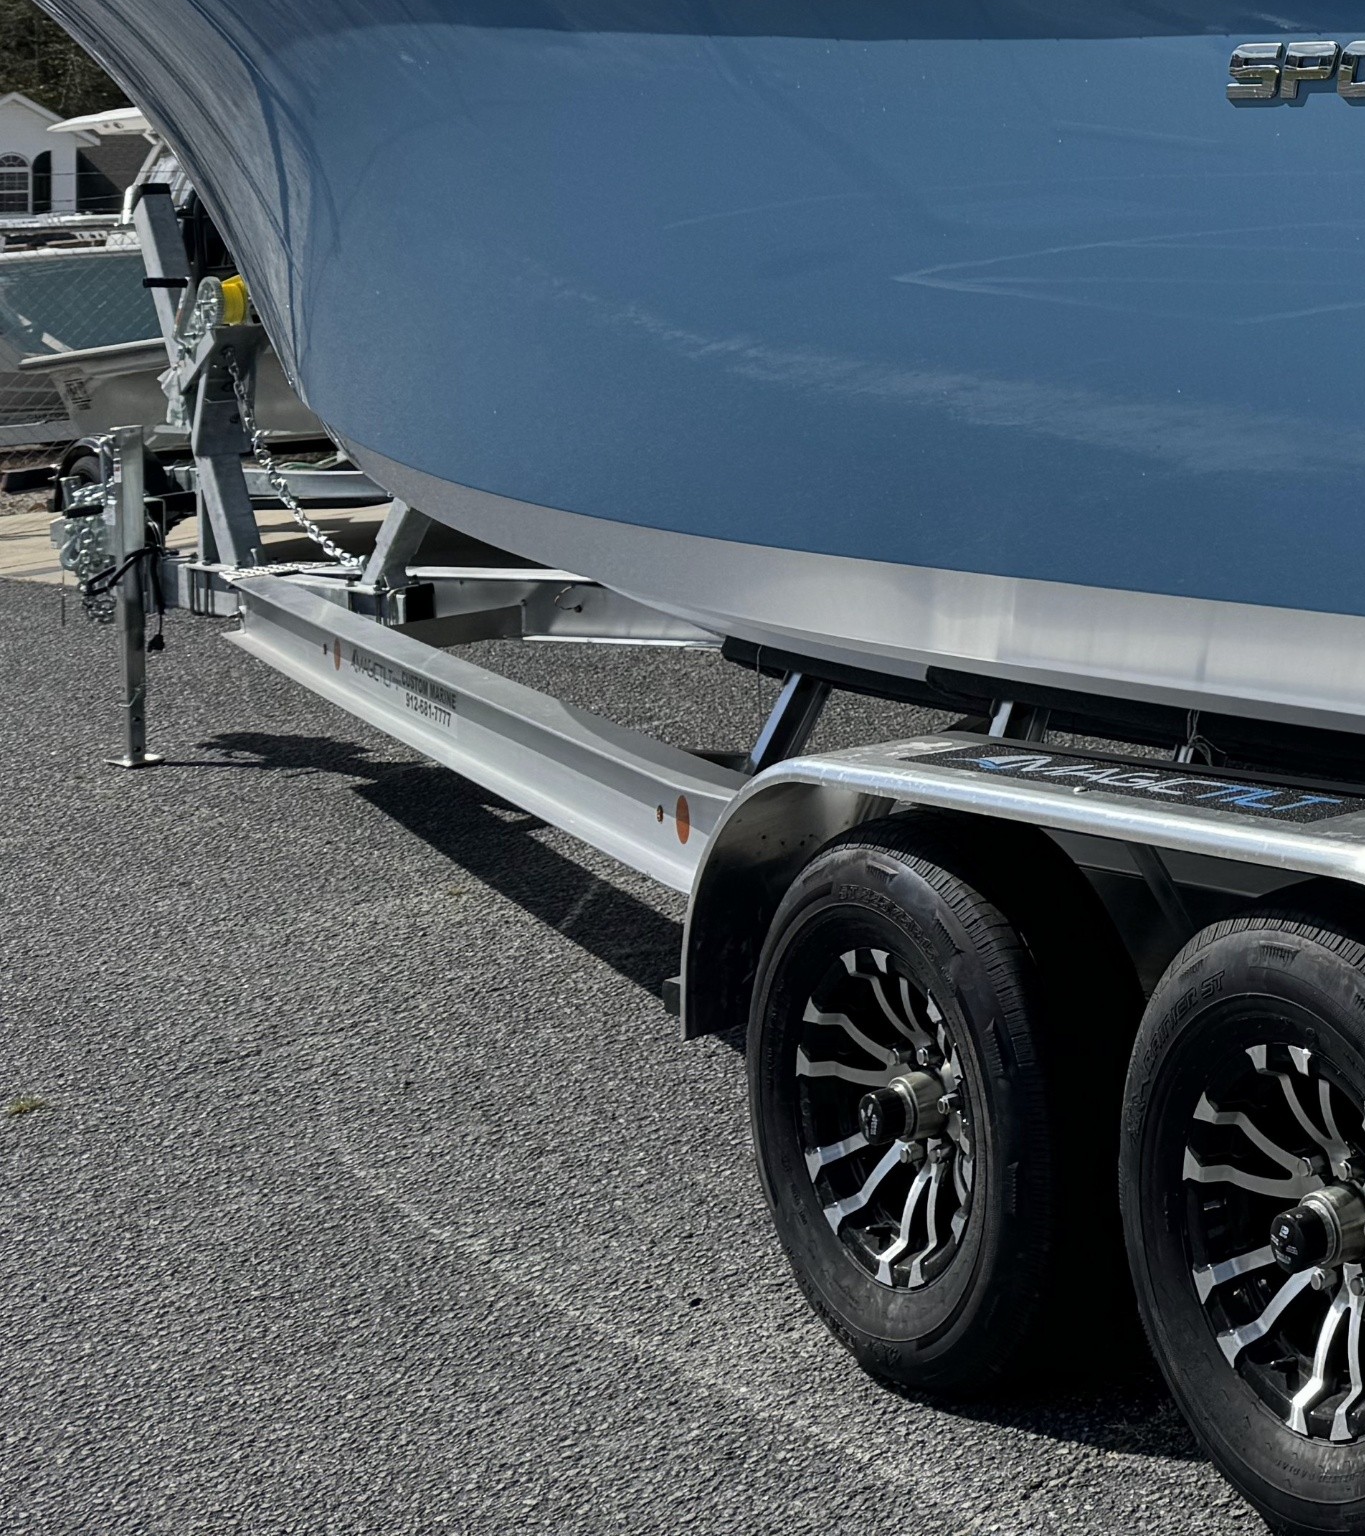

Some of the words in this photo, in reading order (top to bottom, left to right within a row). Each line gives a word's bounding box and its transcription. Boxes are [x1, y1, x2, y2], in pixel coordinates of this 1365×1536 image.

[402, 669, 429, 698] CUSTOM
[431, 681, 457, 711] MARINE
[405, 692, 452, 728] 912-681-7777
